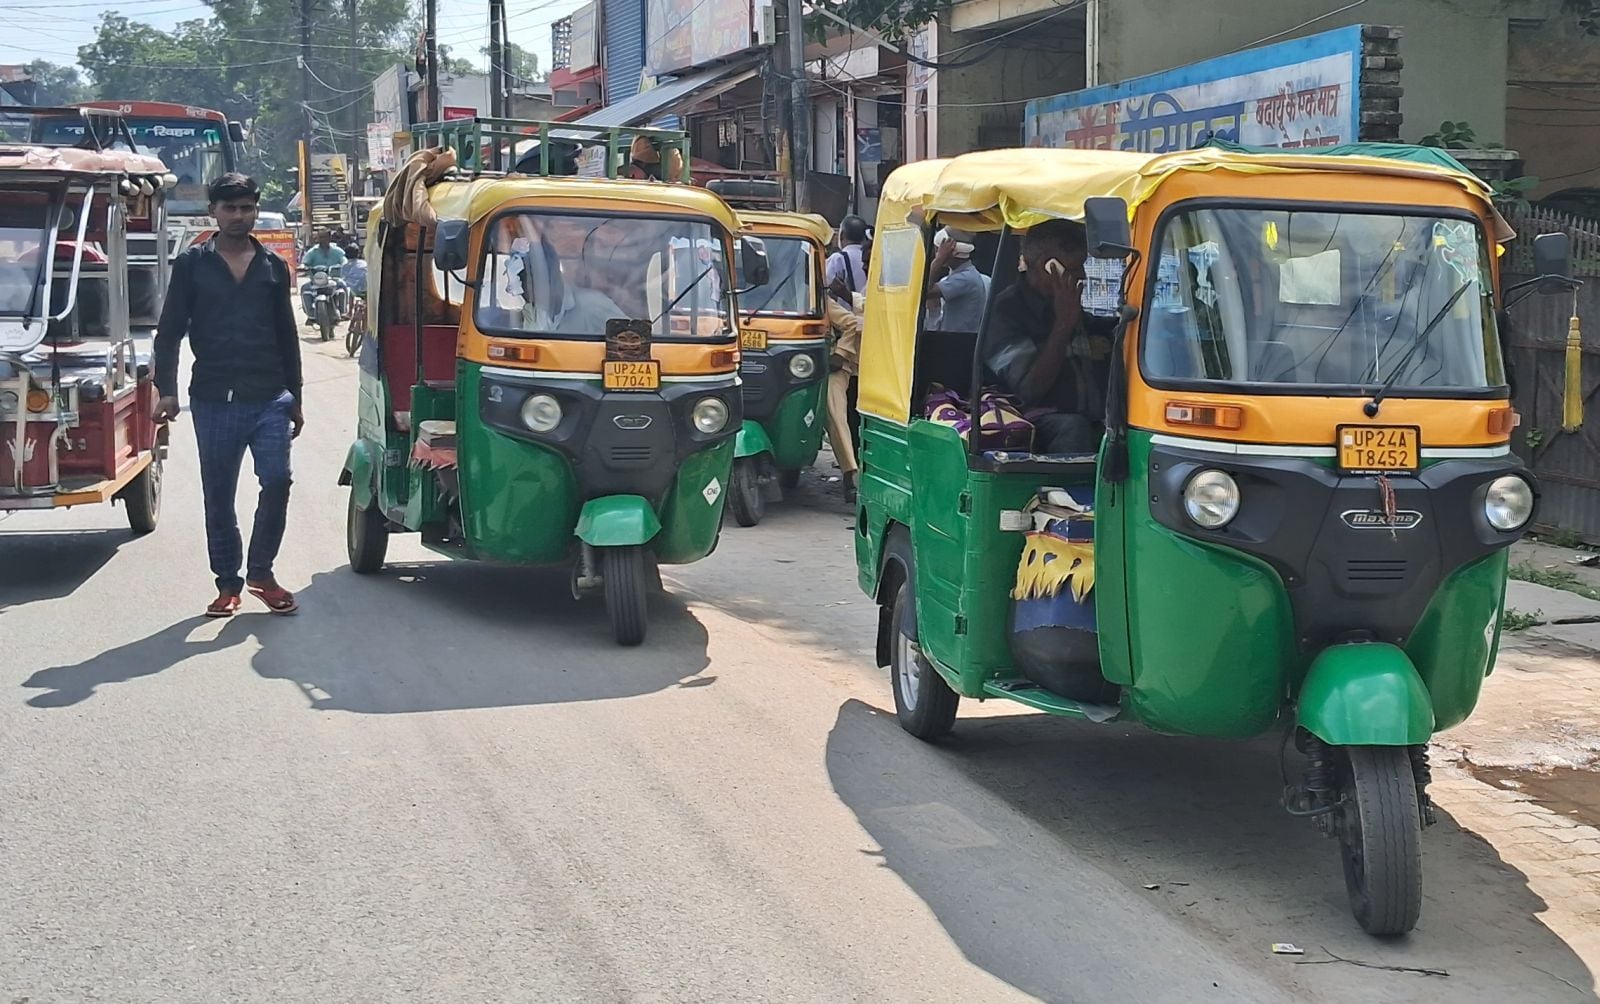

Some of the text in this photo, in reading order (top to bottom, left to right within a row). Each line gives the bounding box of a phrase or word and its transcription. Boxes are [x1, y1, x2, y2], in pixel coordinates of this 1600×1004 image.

[614, 364, 651, 374] UP24A
[615, 376, 652, 386] T7041
[1354, 431, 1406, 447] UP24A
[1356, 450, 1408, 467] T8452
